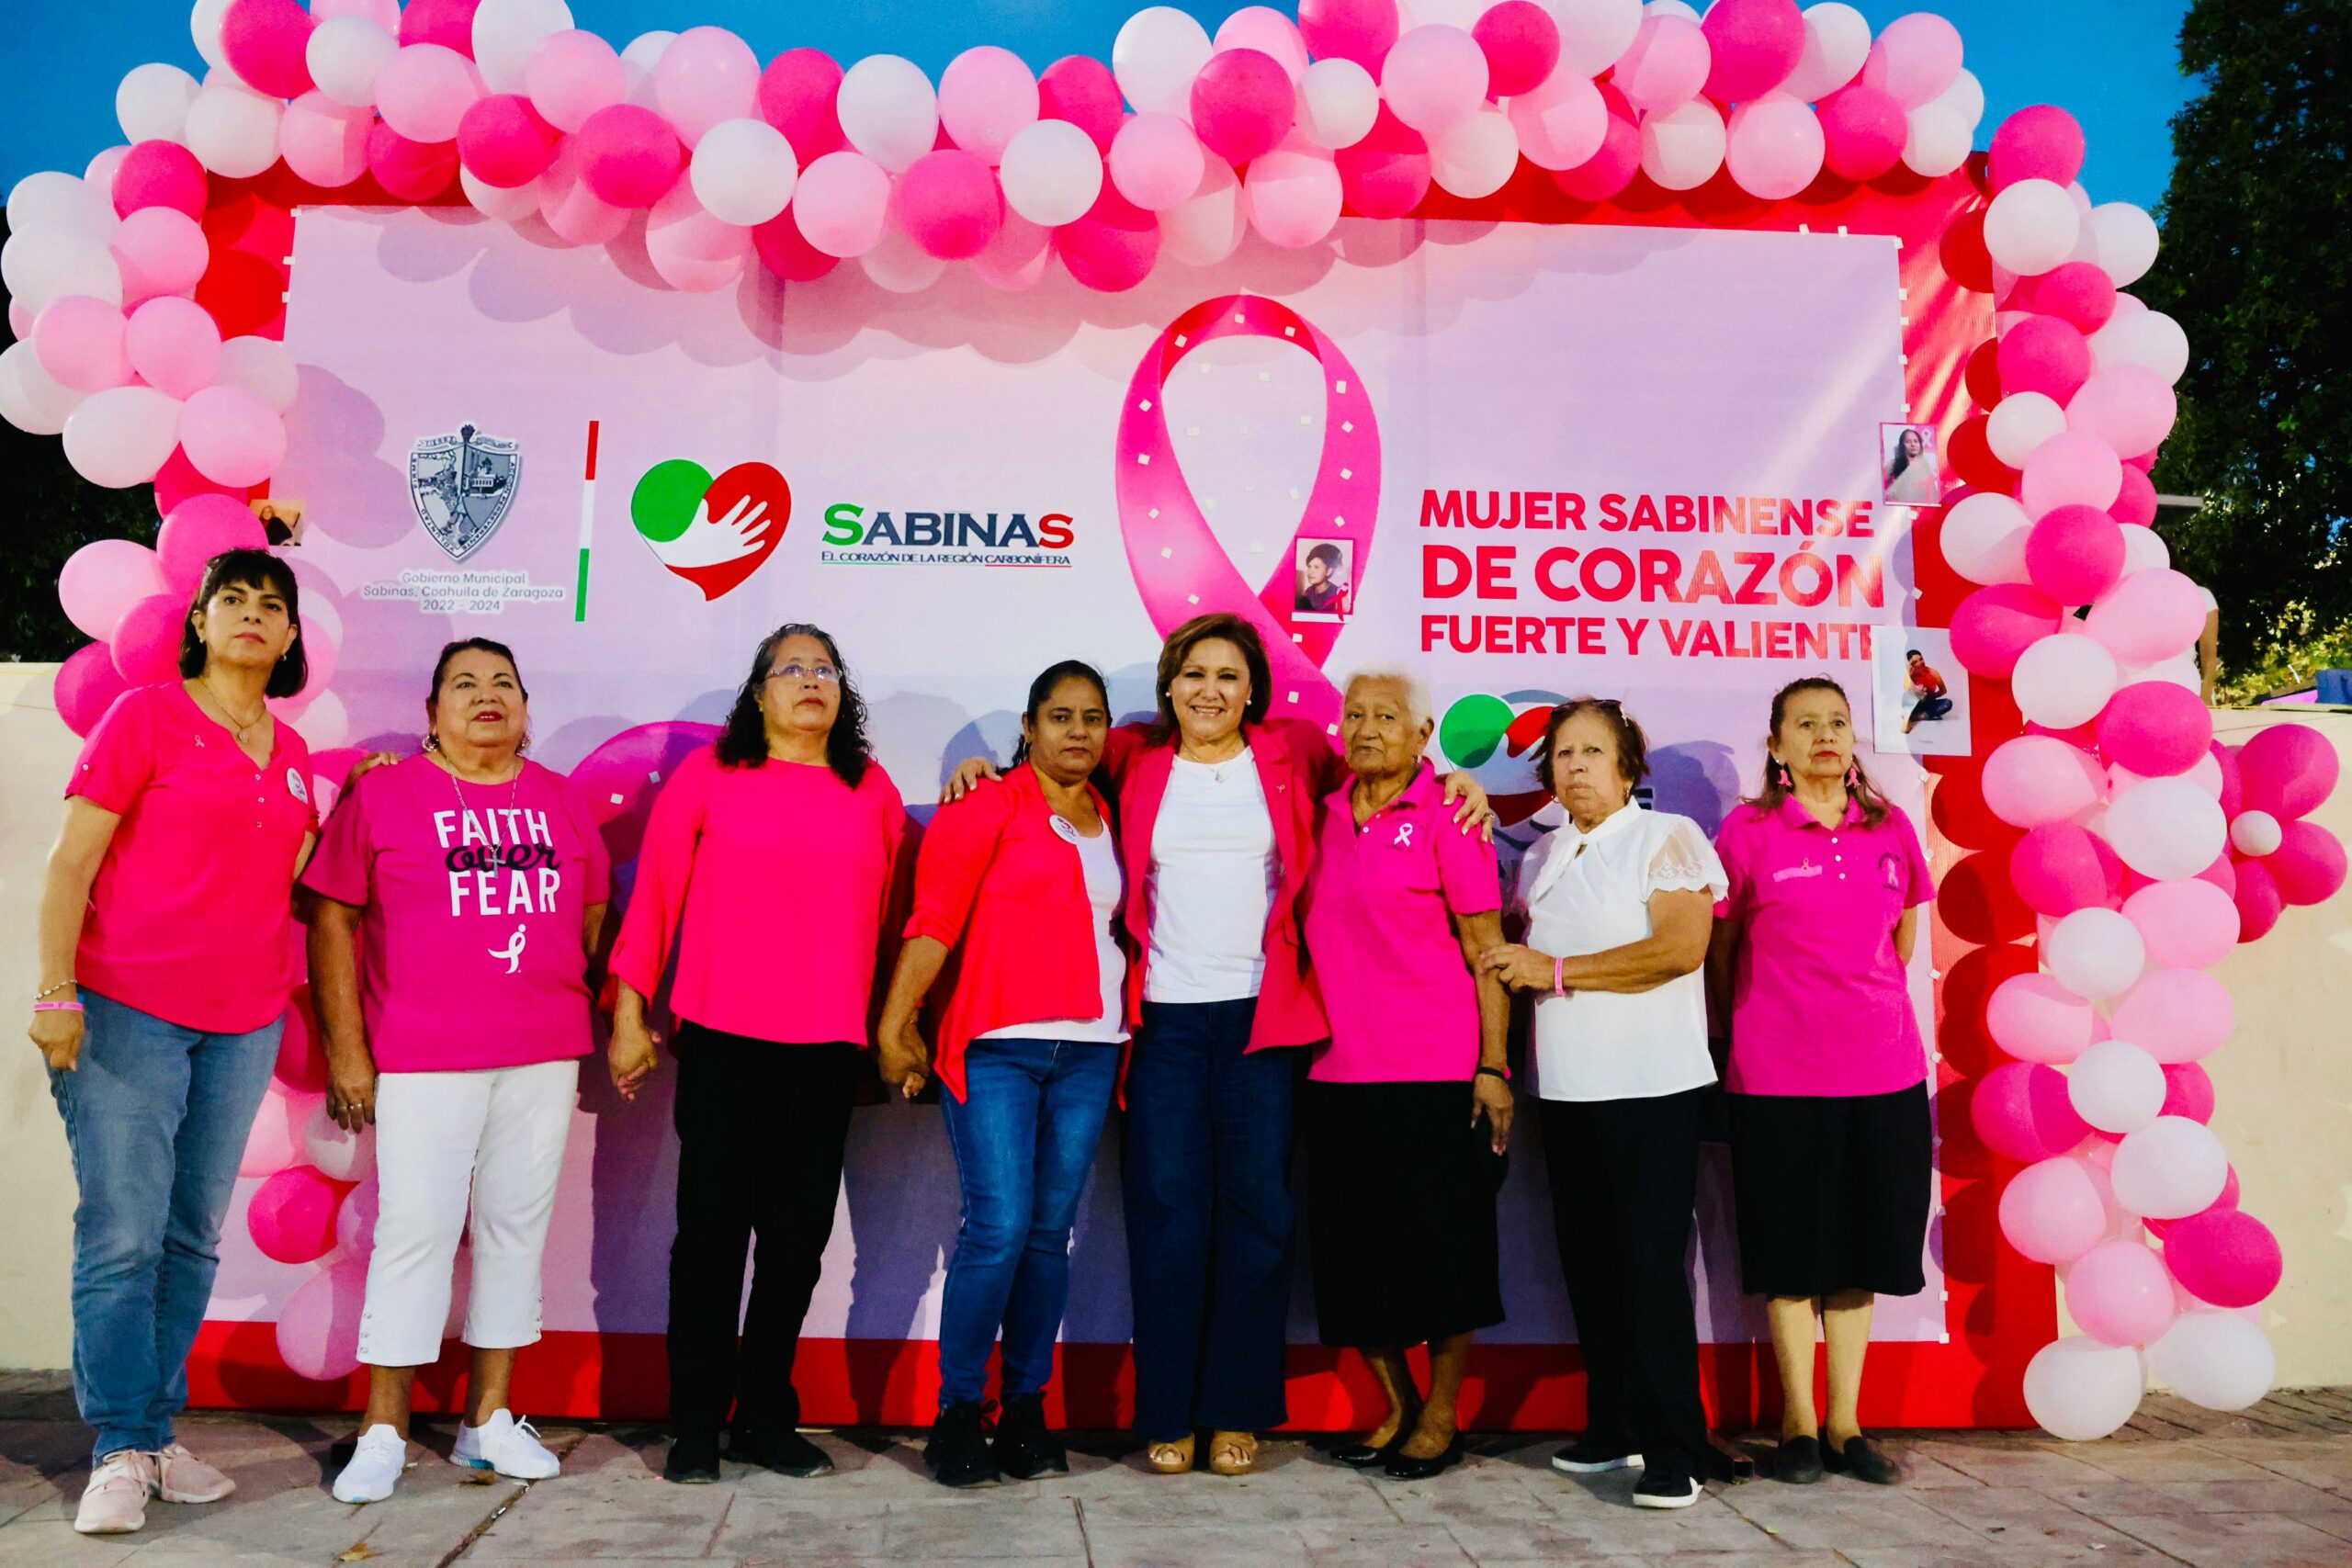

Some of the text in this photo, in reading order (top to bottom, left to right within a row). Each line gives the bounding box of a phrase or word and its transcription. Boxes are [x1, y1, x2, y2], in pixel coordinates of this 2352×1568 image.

[421, 508, 455, 551] VOLUNTAD
[822, 503, 1074, 548] SABINAS
[1419, 489, 1875, 538] MUJER SABINENSE
[839, 550, 900, 562] CORAZÓN
[901, 554, 919, 562] DE
[920, 554, 935, 563] LA
[937, 552, 983, 563] REGIÓN
[1422, 541, 1884, 608] DE CORAZÓN
[363, 585, 563, 600] Sabinas, Coahuila de Zaragoza
[401, 571, 526, 586] Gobierno Municipal
[423, 599, 455, 611] 2022
[469, 600, 501, 611] 2024
[1420, 615, 1606, 655] FUERTE
[1616, 617, 1649, 656] Y
[434, 807, 553, 848] FAITH
[445, 842, 561, 873] over
[449, 867, 560, 917] FEAR
